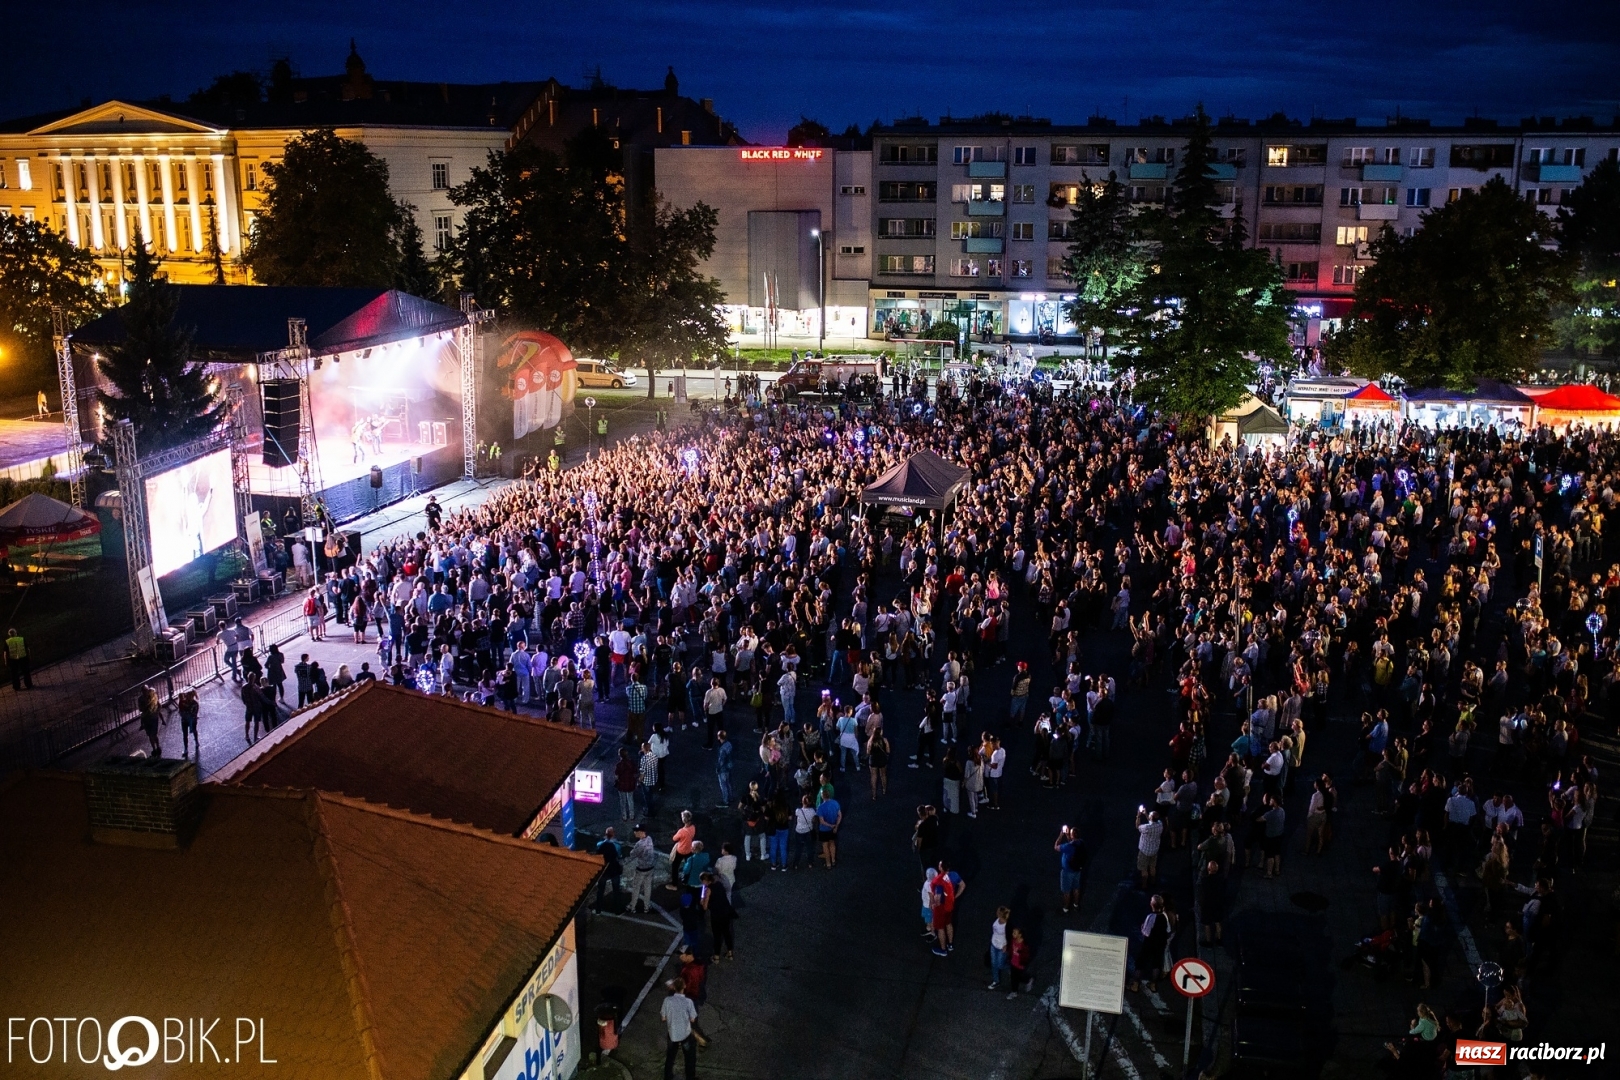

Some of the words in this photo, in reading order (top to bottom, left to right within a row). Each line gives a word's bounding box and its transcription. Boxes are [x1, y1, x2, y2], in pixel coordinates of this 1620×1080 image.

[741, 150, 770, 159] BLACK
[772, 150, 791, 159] RED
[878, 496, 926, 505] www.musicland.pl
[26, 525, 58, 534] TYSKIE
